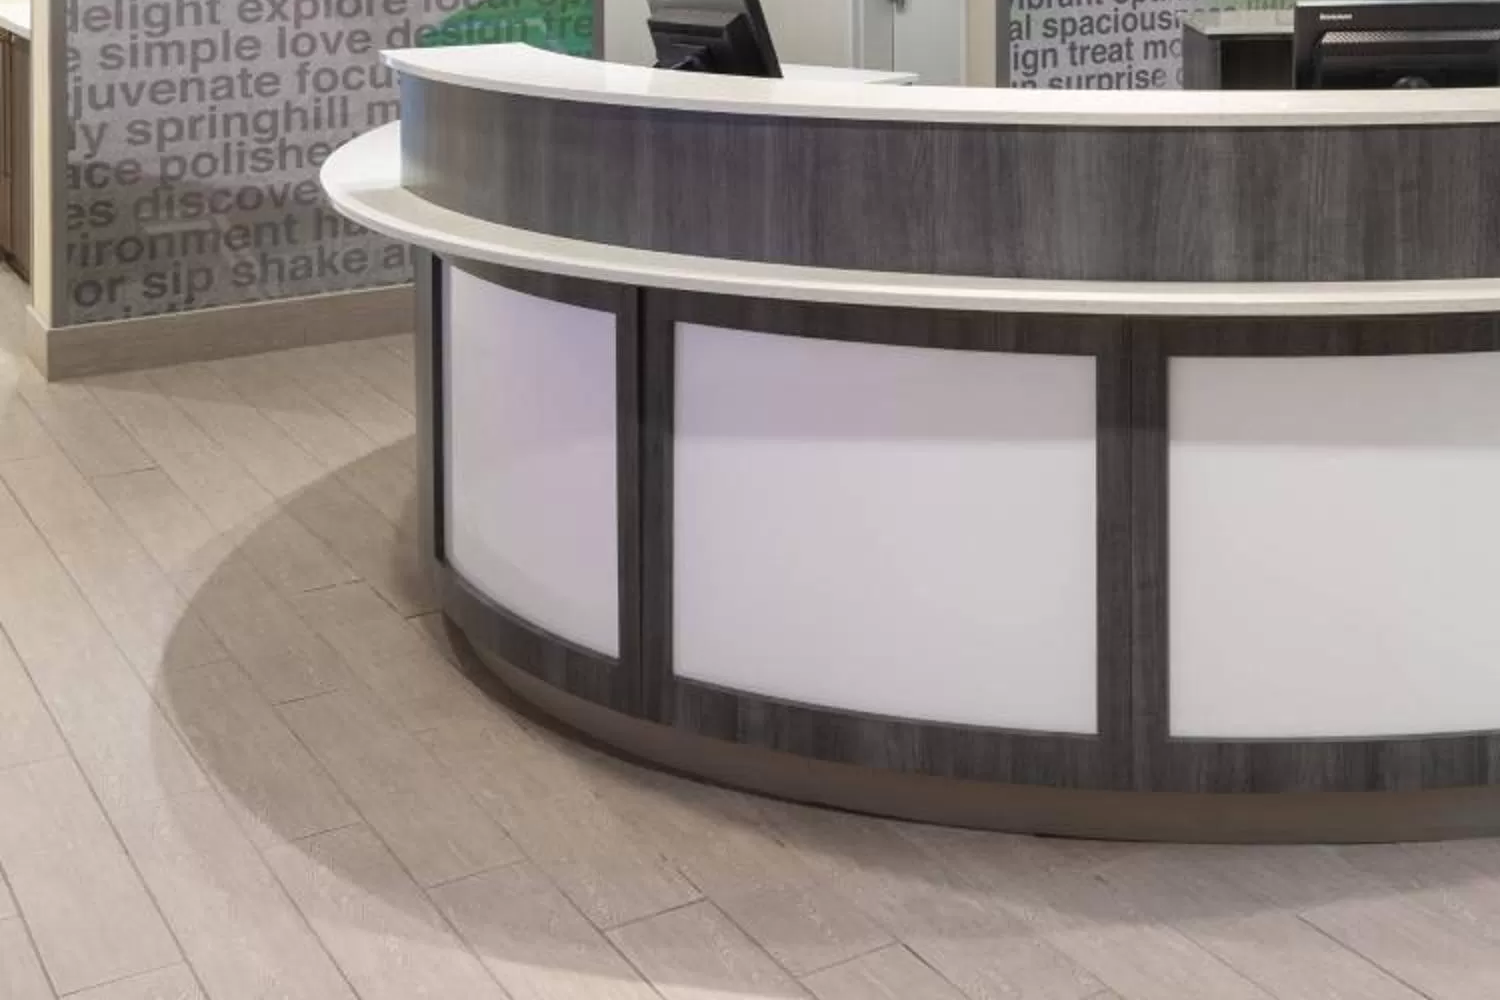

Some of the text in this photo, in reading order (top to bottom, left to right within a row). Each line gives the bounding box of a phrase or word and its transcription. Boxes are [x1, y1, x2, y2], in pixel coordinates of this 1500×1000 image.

[98, 32, 262, 75] simple
[276, 25, 373, 60] love
[1013, 42, 1058, 78] ign
[1067, 36, 1135, 67] treat
[296, 60, 402, 94] focu
[1047, 63, 1167, 91] surprise
[125, 94, 349, 153] springhill
[159, 136, 348, 182] polishe
[134, 178, 326, 224] discove
[142, 257, 215, 302] sip
[230, 244, 370, 287] shake
